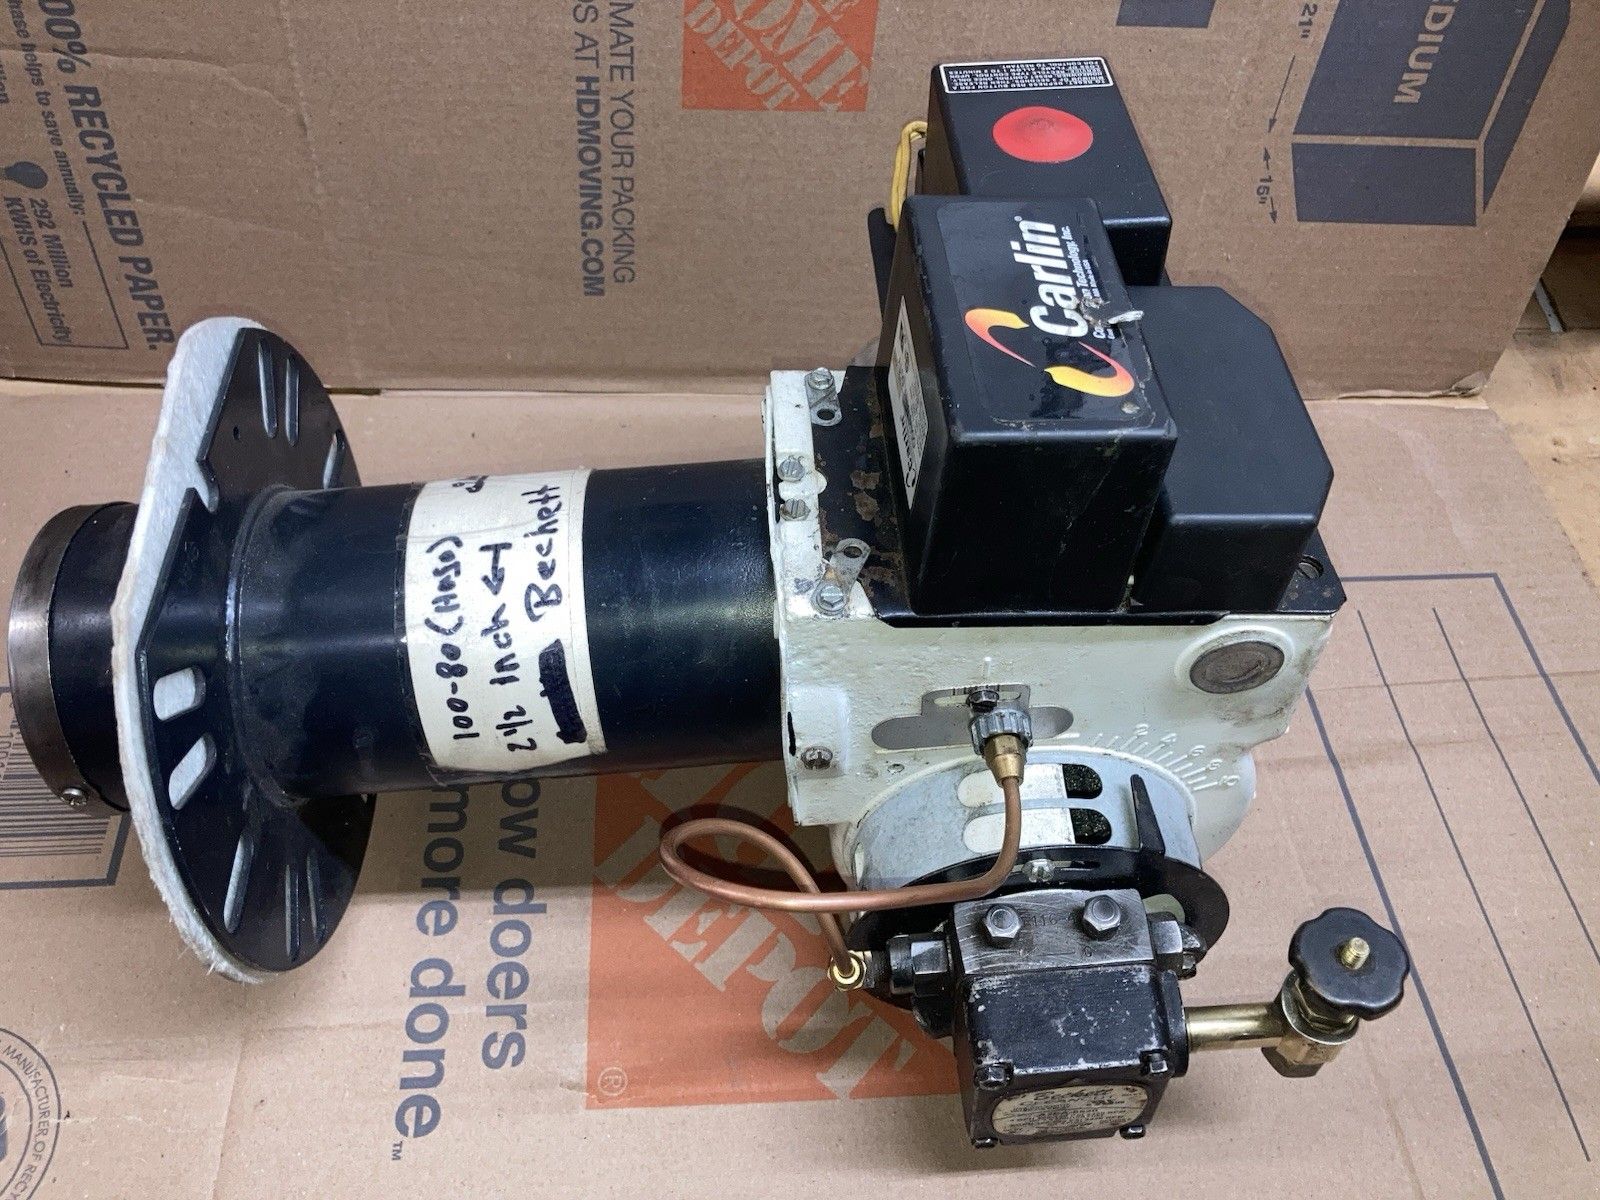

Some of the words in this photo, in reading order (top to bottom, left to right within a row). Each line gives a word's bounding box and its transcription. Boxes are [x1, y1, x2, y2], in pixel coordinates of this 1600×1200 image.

[573, 0, 599, 23] S
[574, 31, 599, 69] AT
[1393, 0, 1459, 103] DIUM
[21, 43, 45, 86] helps
[684, 0, 801, 110] DEPOT
[35, 91, 51, 106] to
[41, 110, 64, 147] save
[609, 89, 635, 169] YOUR
[4, 196, 38, 246] KWHS
[29, 198, 56, 230] 292
[54, 150, 85, 215] annually:
[64, 85, 144, 246] RECYCLED
[118, 255, 175, 349] PAPER.
[575, 75, 605, 297] HDMOVING.COM
[23, 249, 46, 266] of
[42, 234, 73, 288] Million
[610, 176, 636, 284] PACKING
[30, 268, 72, 343] Electricity
[1010, 219, 1089, 338] Carlin
[416, 783, 470, 937] more
[482, 878, 548, 1070] doers
[594, 814, 918, 1101] DEPOT
[395, 956, 466, 1139] done
[4, 1045, 50, 1136] MANUFACTURER
[32, 1141, 46, 1162] OF
